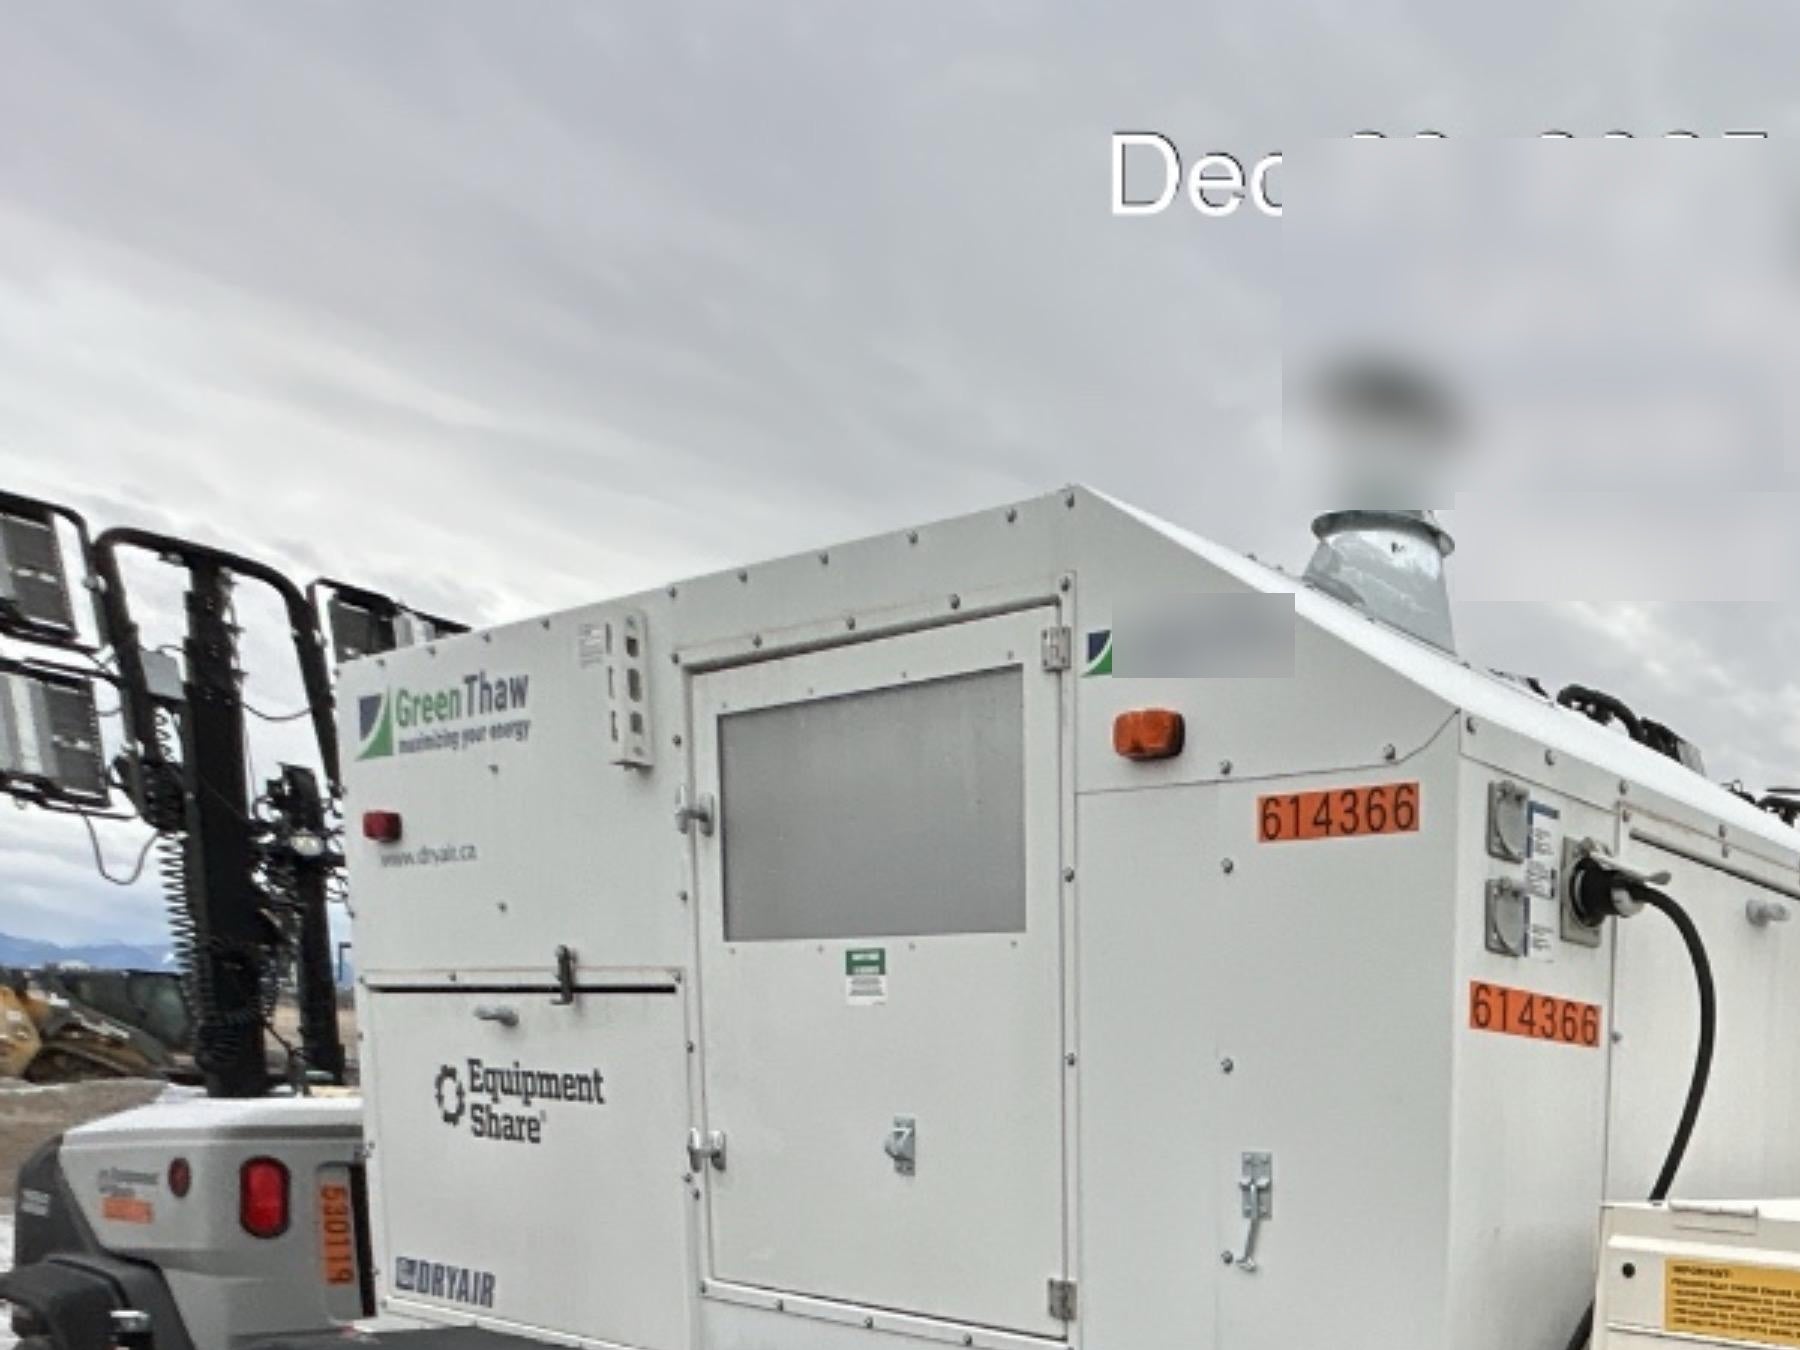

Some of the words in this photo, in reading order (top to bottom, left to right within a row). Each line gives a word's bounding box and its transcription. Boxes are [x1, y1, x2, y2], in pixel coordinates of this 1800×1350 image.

[1261, 783, 1415, 840] 614366
[1472, 983, 1598, 1046] 614366
[467, 1058, 606, 1106] Equipment
[470, 1102, 542, 1144] Share
[416, 1259, 497, 1309] DRYAIR
